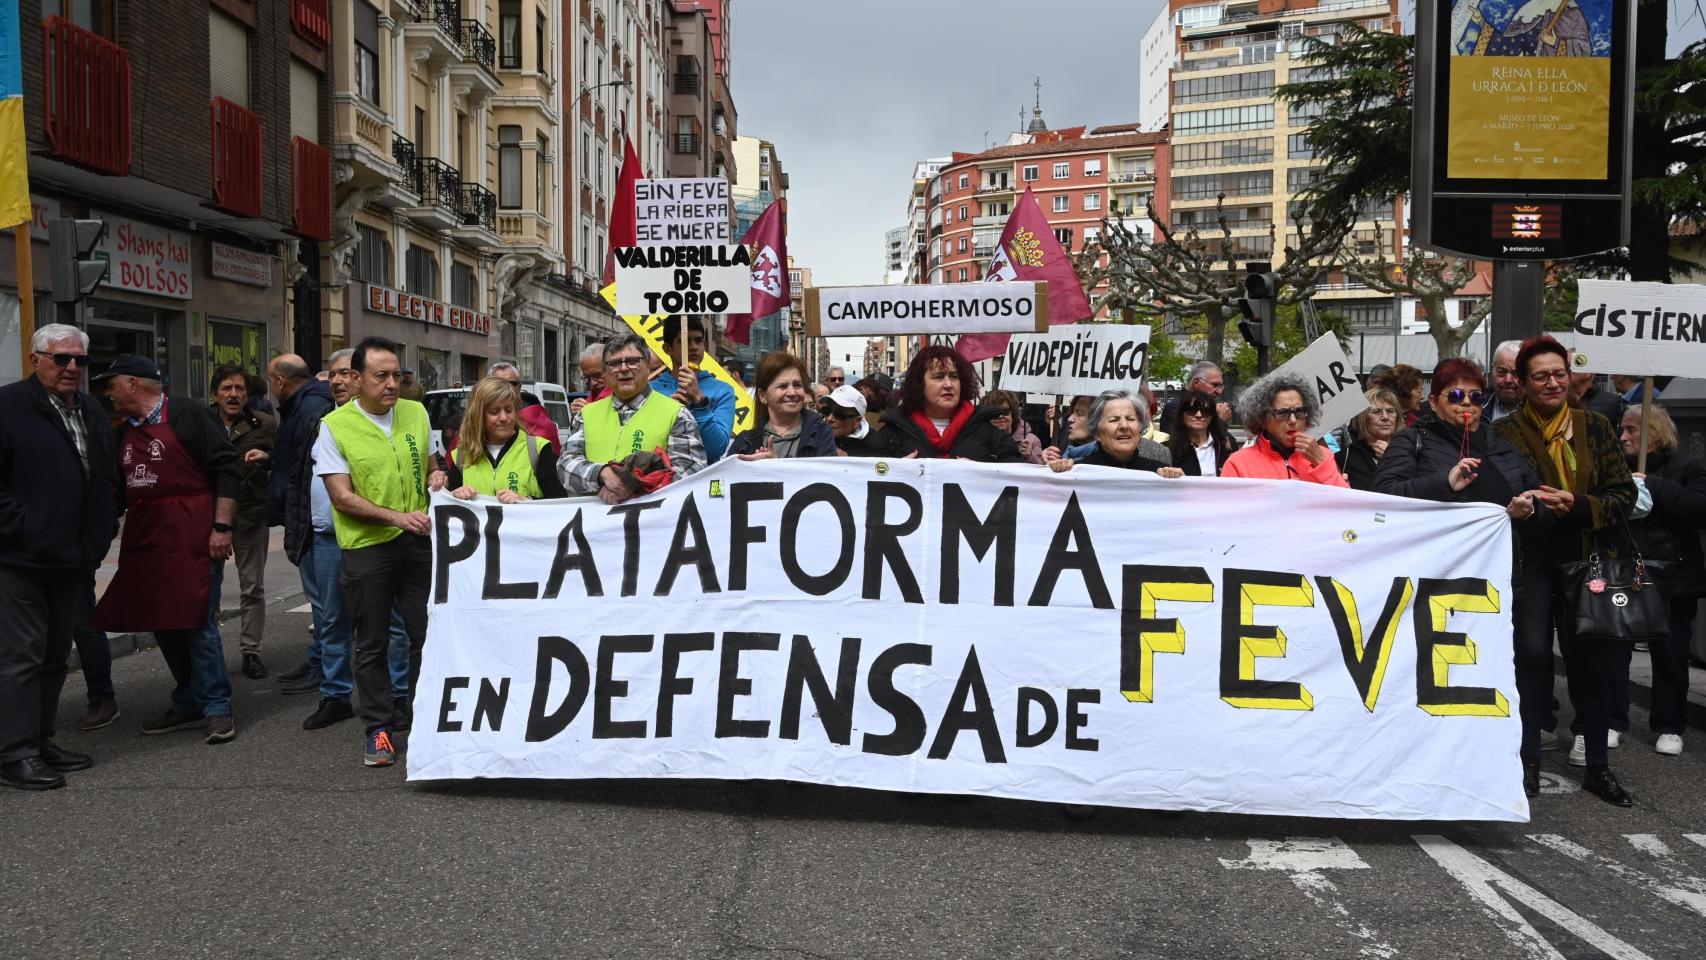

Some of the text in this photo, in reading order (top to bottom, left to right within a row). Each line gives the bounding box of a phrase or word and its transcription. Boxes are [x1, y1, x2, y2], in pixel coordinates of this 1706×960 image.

[1492, 67, 1568, 80] REINA ELLA
[1472, 81, 1526, 94] URRACA
[1552, 80, 1588, 93] LEÓN
[636, 180, 728, 200] SIN FEVE
[636, 201, 728, 220] LA RIBERA
[637, 222, 728, 241] SE MUERE
[614, 244, 751, 268] VALDERILLA
[120, 261, 188, 296] BOLSOS
[673, 269, 702, 291] DE
[644, 290, 729, 314] TORIO
[827, 298, 1033, 320] CAMPOHERMOSO
[1574, 303, 1706, 343] CISTIERN
[1008, 331, 1149, 380] VALDEPIÉLAGO
[434, 480, 1115, 609] PLATAFORMA
[437, 564, 1510, 763] EN DEFENSA DE FEVE
